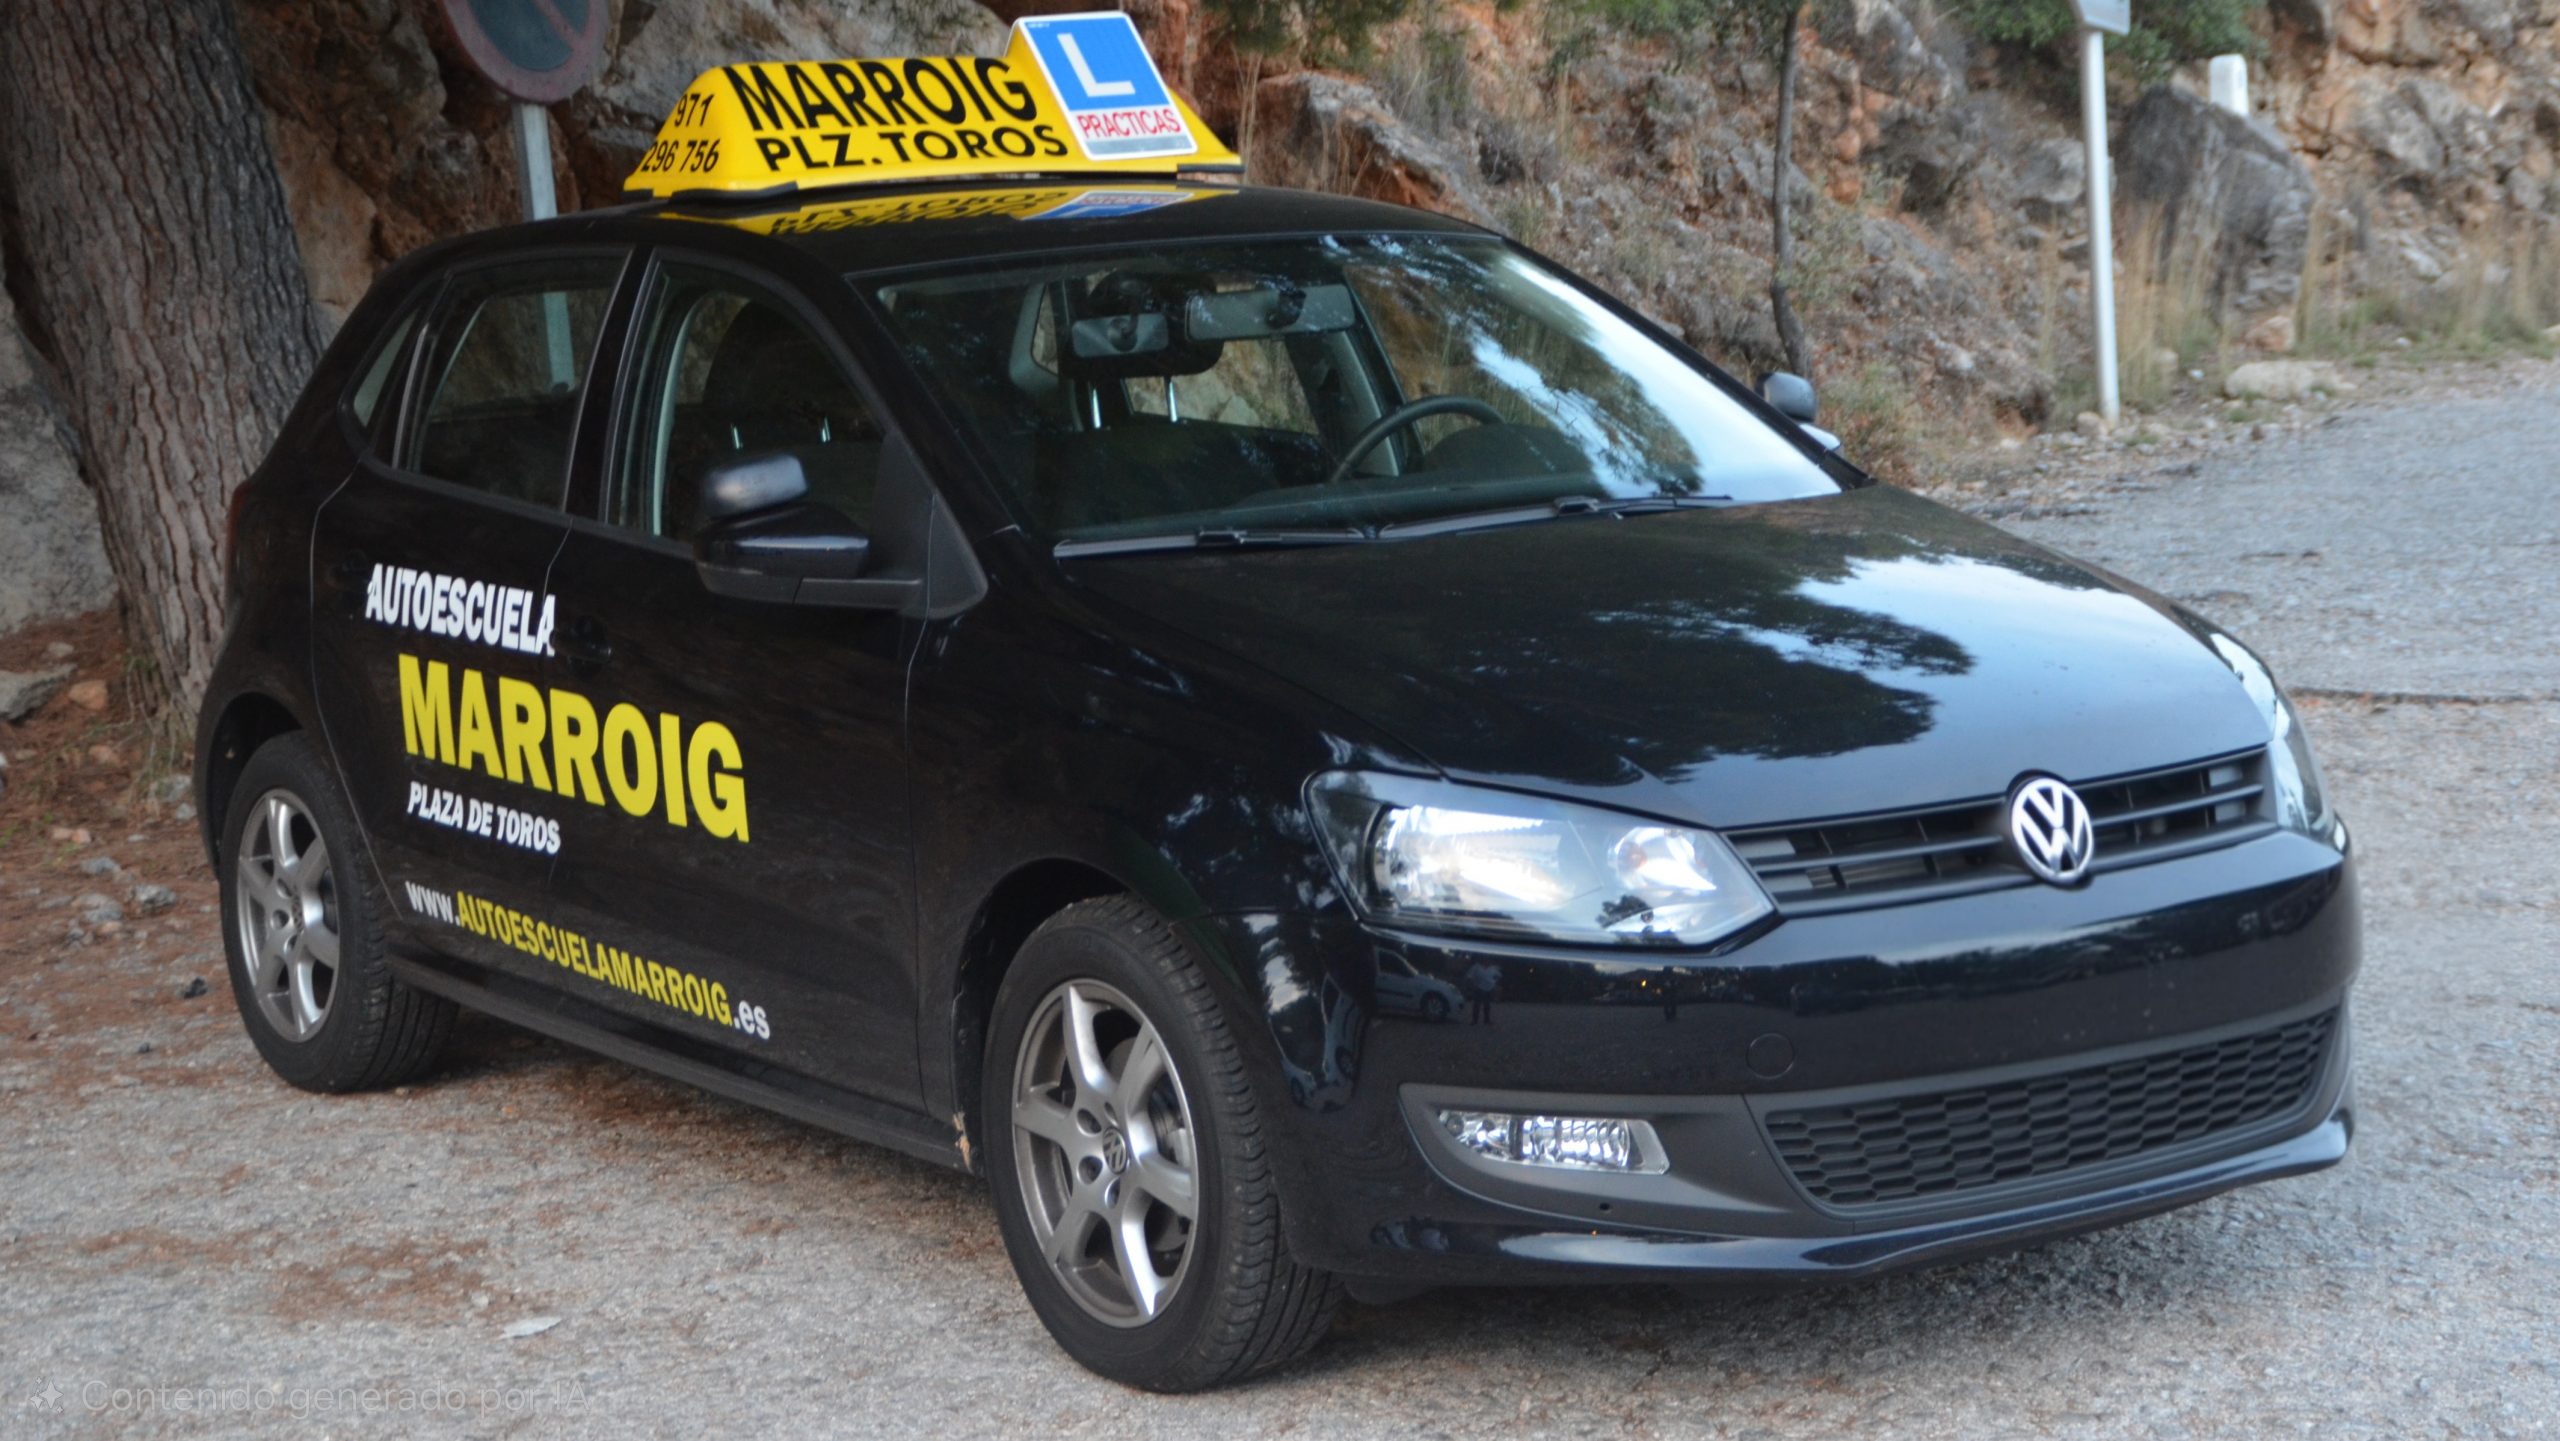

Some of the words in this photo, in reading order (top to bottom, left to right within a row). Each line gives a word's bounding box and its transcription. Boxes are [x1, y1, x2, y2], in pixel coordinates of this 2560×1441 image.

[721, 57, 1038, 132] MARROIG
[1056, 32, 1136, 98] L
[674, 93, 715, 128] 971
[1076, 108, 1182, 139] PRACTICAS
[641, 139, 679, 173] 296
[680, 138, 720, 173] 756
[756, 124, 1069, 171] PLZ.TOROS
[365, 562, 557, 658] AUTOESCUELA
[399, 653, 750, 843] MARROIG
[407, 780, 464, 829] PLAZA
[466, 798, 495, 837] DE
[496, 805, 562, 855] TOROS
